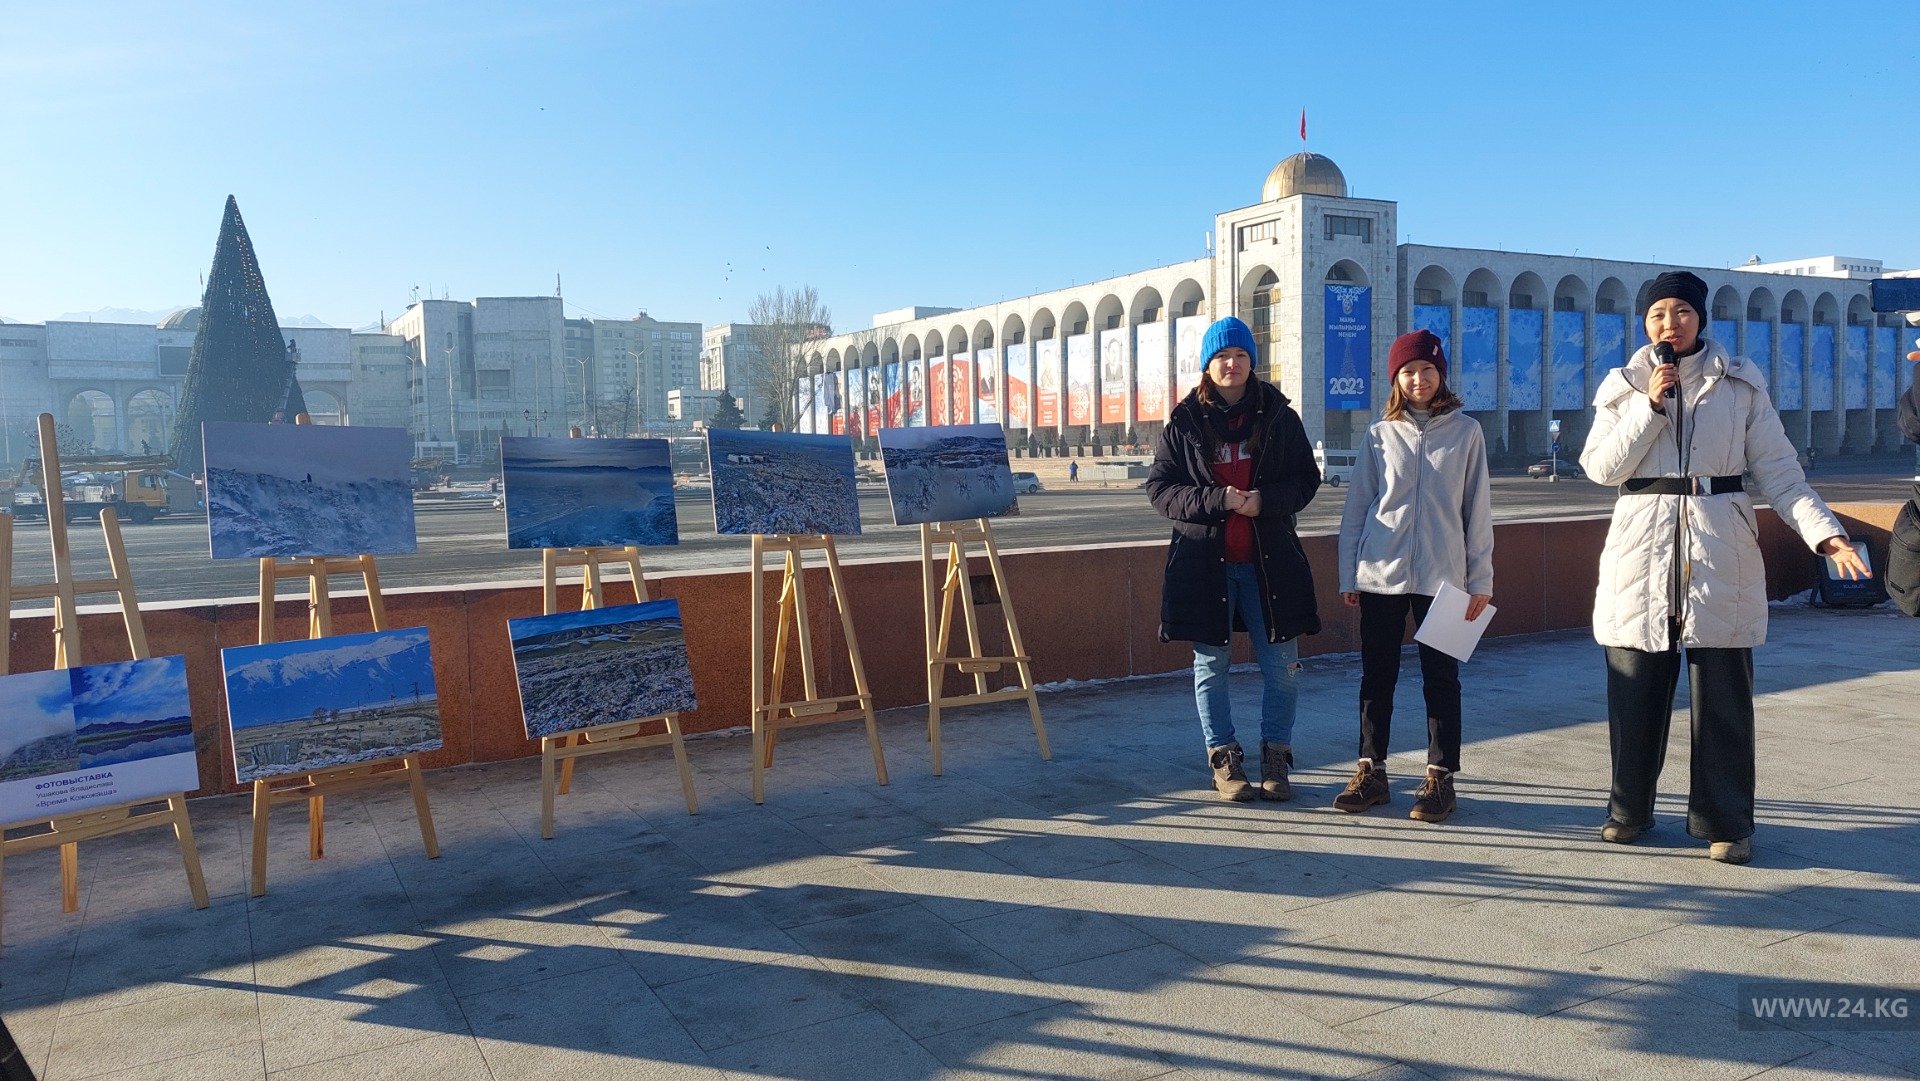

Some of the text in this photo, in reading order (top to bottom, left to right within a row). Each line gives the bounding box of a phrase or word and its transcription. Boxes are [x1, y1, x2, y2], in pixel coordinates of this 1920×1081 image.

[1329, 377, 1365, 395] 2023
[35, 772, 113, 790] ФОТОВЫСТАВКА
[36, 781, 114, 798] Ушакова Владислава
[35, 798, 68, 808] «Время
